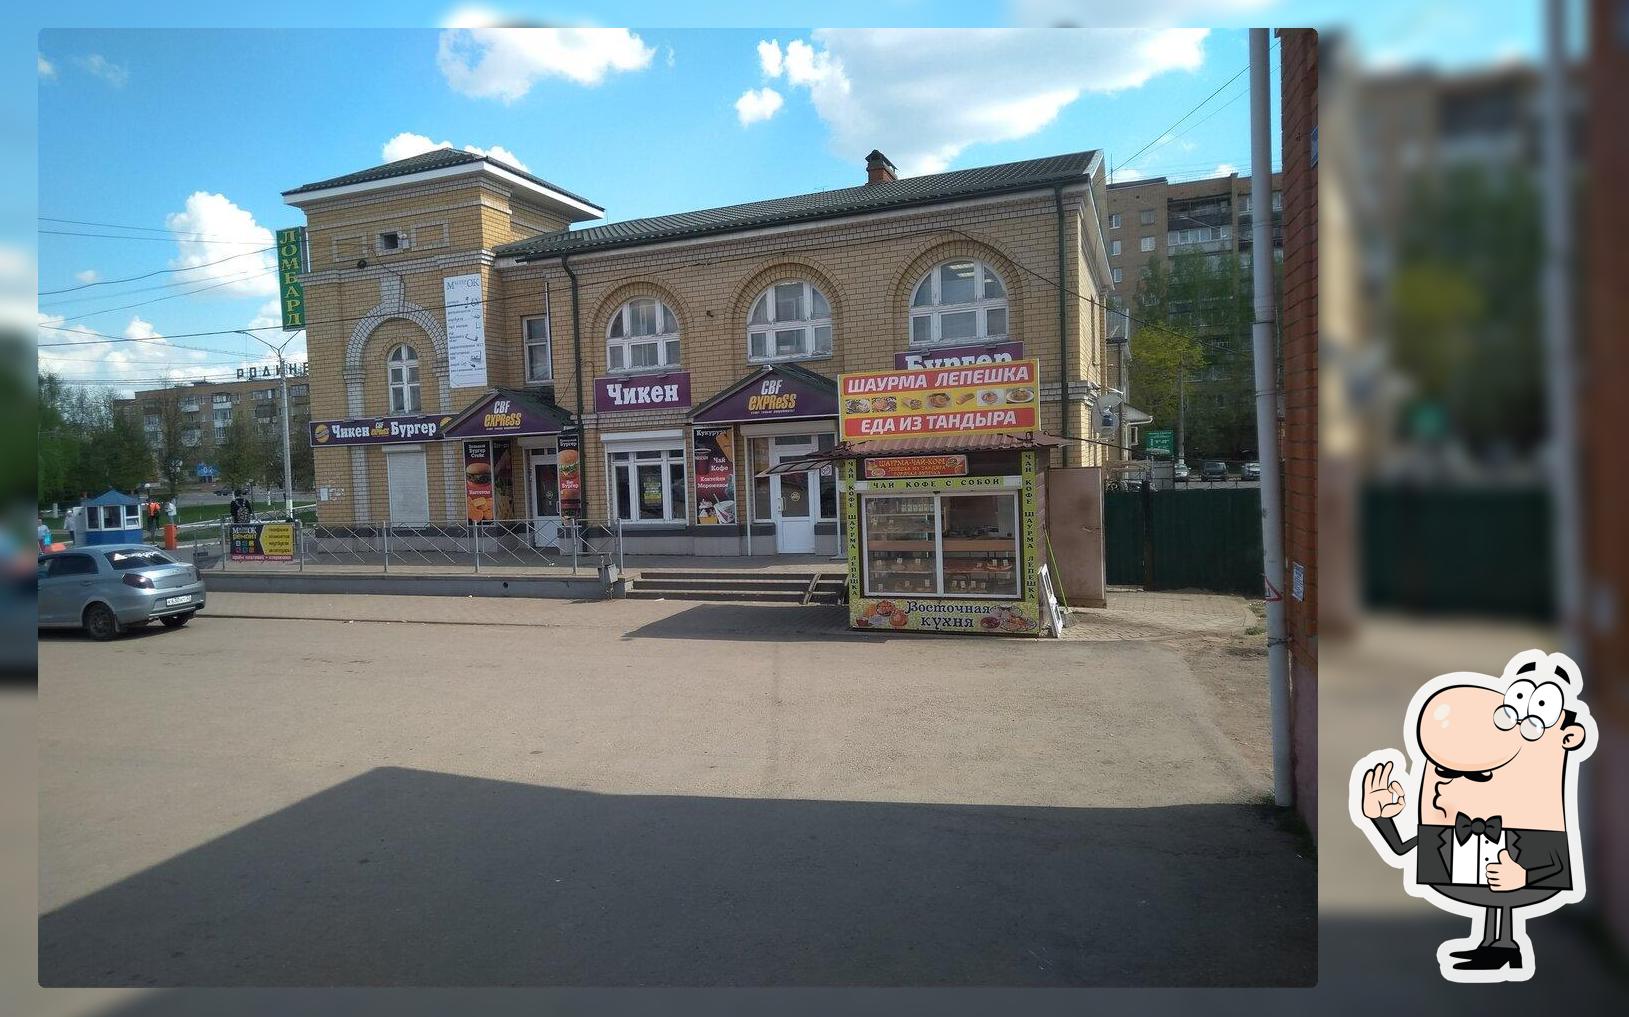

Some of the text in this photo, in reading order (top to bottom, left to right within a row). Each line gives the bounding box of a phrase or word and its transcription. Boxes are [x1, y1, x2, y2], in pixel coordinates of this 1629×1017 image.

[280, 230, 301, 325] ЛОМБАРД
[761, 380, 783, 395] CBF
[847, 366, 1029, 393] ШАУРМА ЛЕПЕШКА
[606, 384, 679, 405] Чикен
[493, 400, 510, 414] CBF
[331, 424, 370, 438] Чикен
[390, 421, 437, 437] Бургер
[861, 410, 1017, 435] ЕДА ИЗ ТАНДЫРА
[873, 481, 894, 489] ЧАЙ
[848, 514, 857, 549] ШАУРМА
[1024, 511, 1034, 549] ШАУРМА
[904, 600, 992, 614] Восточная
[920, 617, 974, 629] кухня
